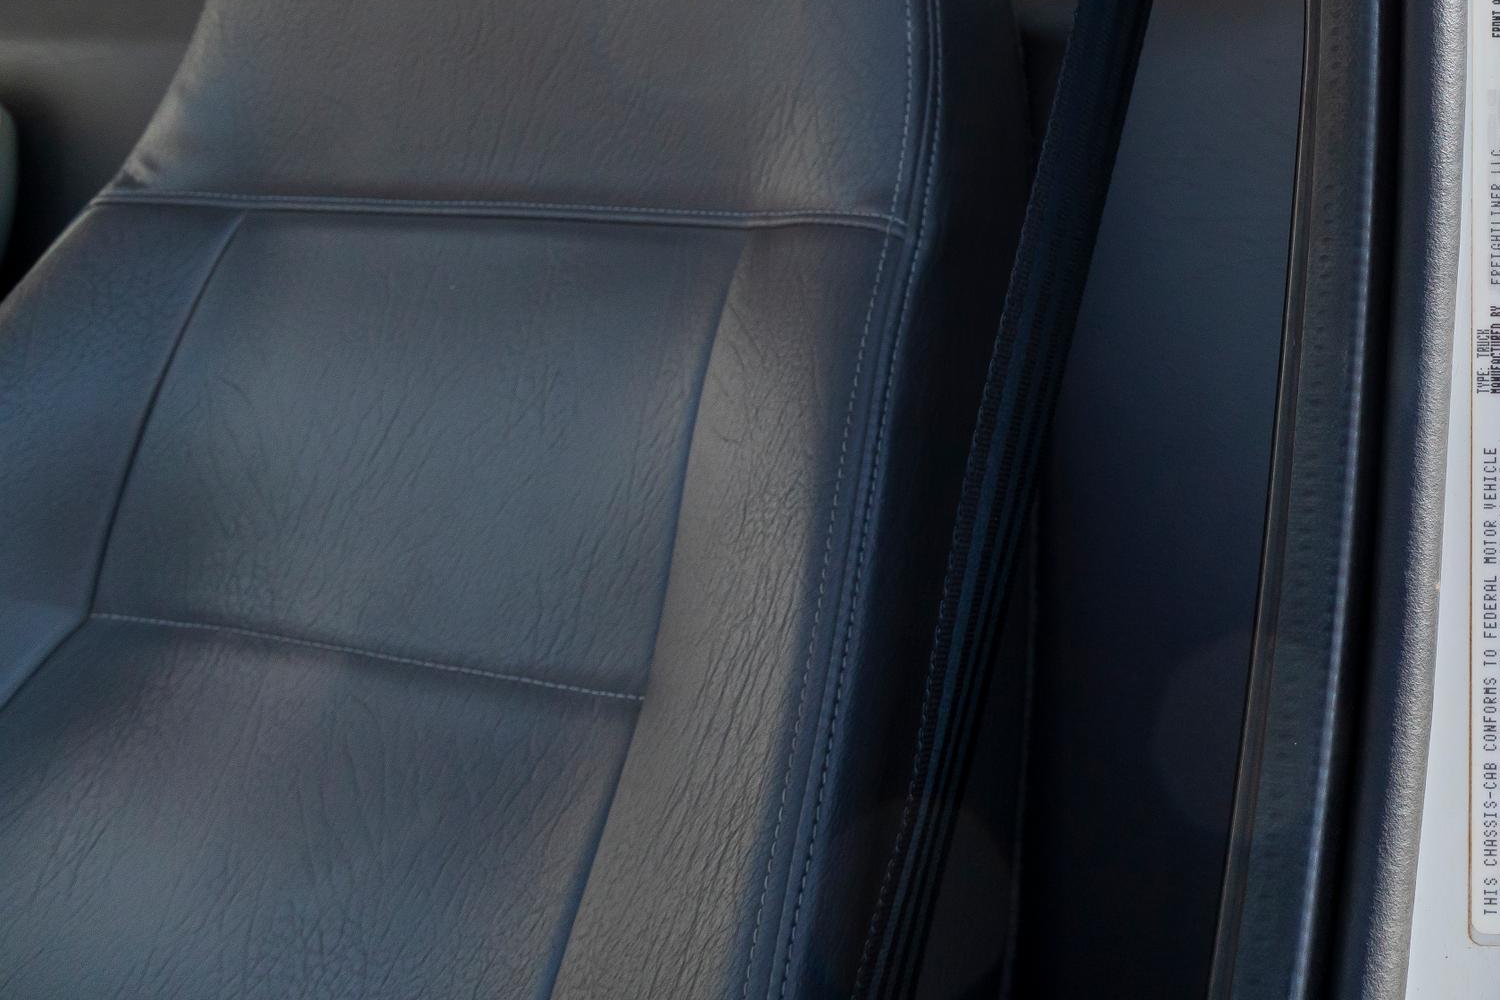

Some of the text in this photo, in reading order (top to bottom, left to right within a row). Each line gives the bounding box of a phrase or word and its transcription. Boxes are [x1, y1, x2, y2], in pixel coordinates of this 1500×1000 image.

[1477, 329, 1490, 394] TYPE: TRUCK
[1484, 448, 1498, 915] THIS CHASSIS-CAB CONFORMS TO FEDERAL MOTOR VEHICLE
